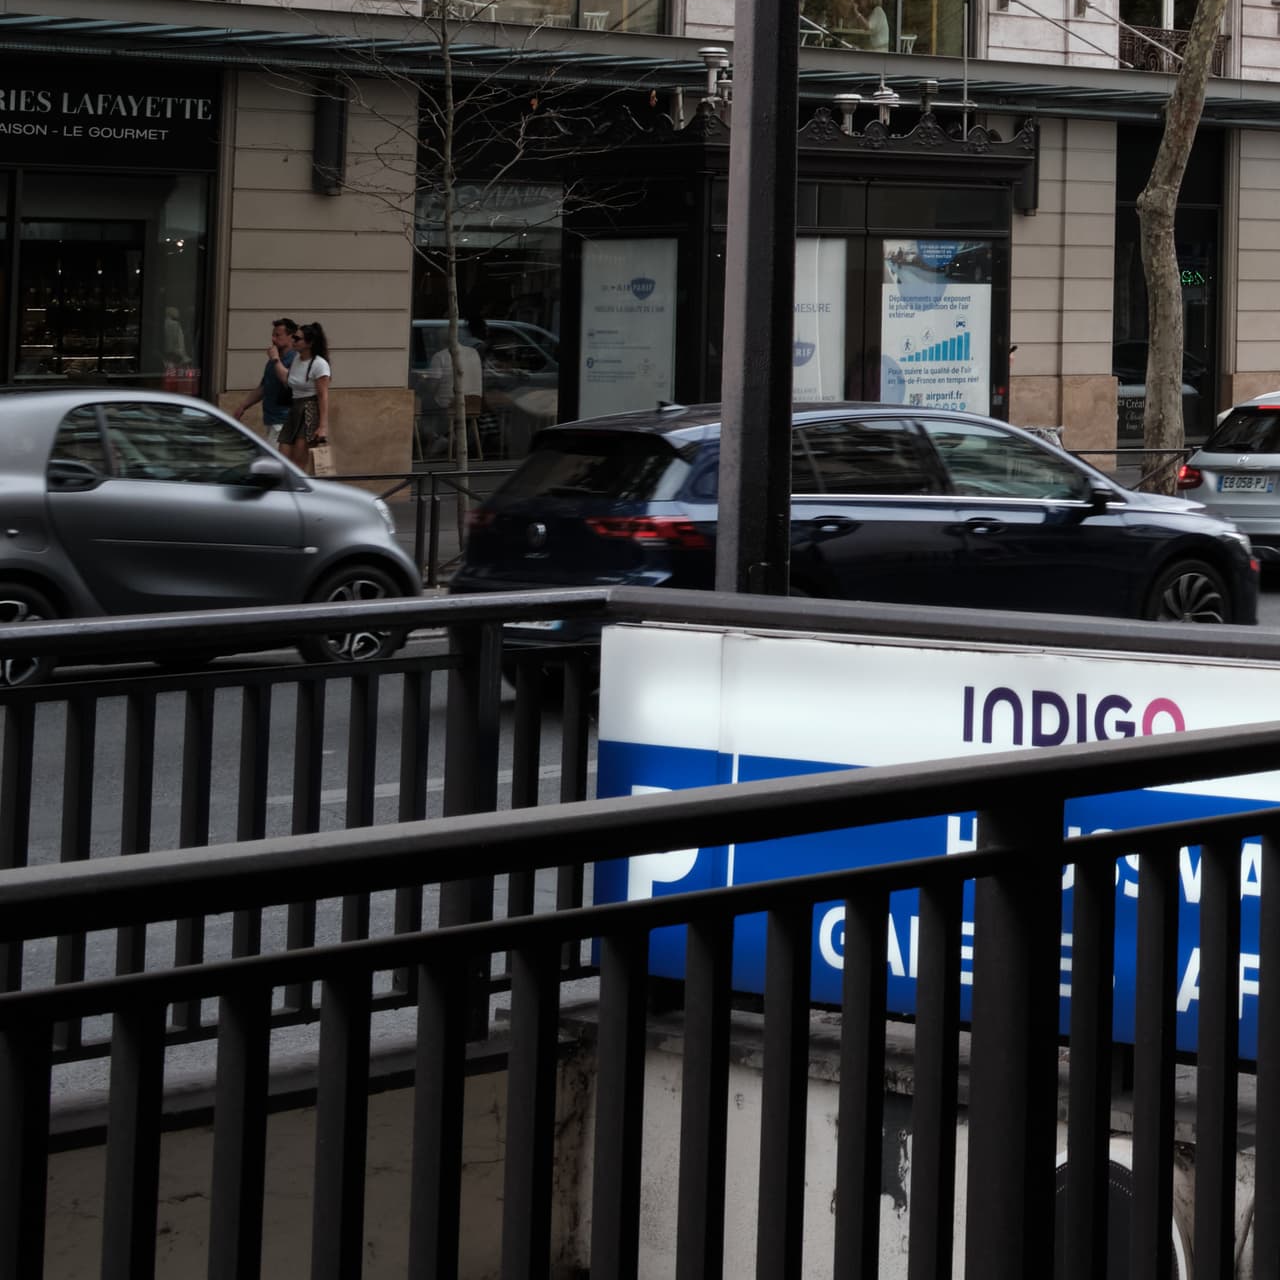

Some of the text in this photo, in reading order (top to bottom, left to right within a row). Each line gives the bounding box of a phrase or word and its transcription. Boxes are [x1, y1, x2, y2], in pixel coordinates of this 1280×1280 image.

[62, 92, 213, 120] LAFAYETTE
[63, 126, 83, 137] LE
[88, 127, 169, 141] GOURMET
[943, 295, 971, 303] exposent
[926, 390, 963, 402] airparif.fr
[963, 685, 1186, 747] INDIGO
